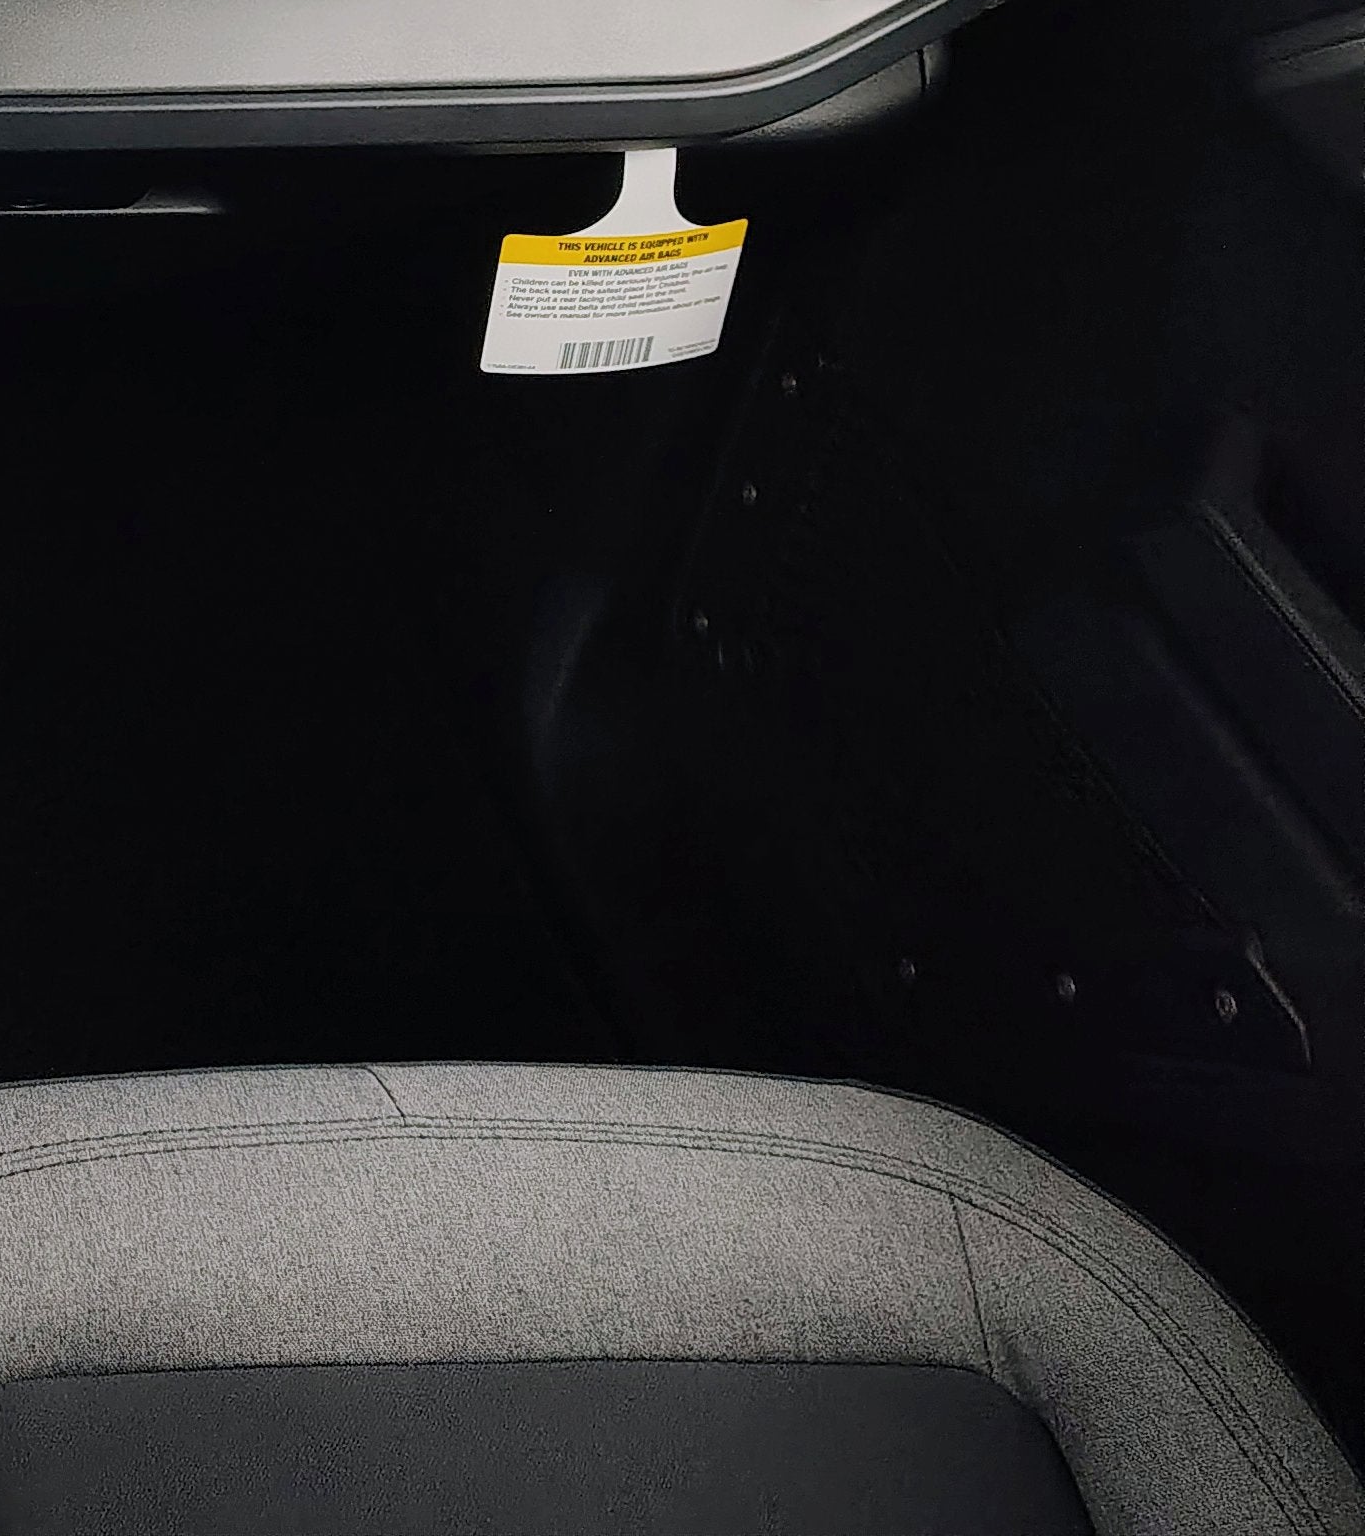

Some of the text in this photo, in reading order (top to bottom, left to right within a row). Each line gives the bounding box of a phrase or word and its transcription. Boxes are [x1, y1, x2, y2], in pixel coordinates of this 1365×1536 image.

[558, 241, 582, 251] THIS
[584, 241, 625, 251] VEHICLE
[627, 241, 638, 251] IS
[687, 232, 710, 243] WITH
[583, 253, 638, 263] ADVANCED
[568, 269, 589, 277] EVEN
[591, 269, 613, 277] WITH
[614, 266, 654, 276] ADVANCED
[511, 277, 549, 286] Children
[568, 279, 580, 287] be
[510, 286, 527, 294] The
[528, 286, 550, 294] back
[551, 287, 570, 295] seat
[571, 287, 580, 295] is
[581, 287, 595, 295] the
[508, 294, 535, 302] Never
[536, 296, 551, 304] put
[578, 296, 605, 304] facing
[506, 303, 539, 312] Always
[506, 310, 523, 318] See
